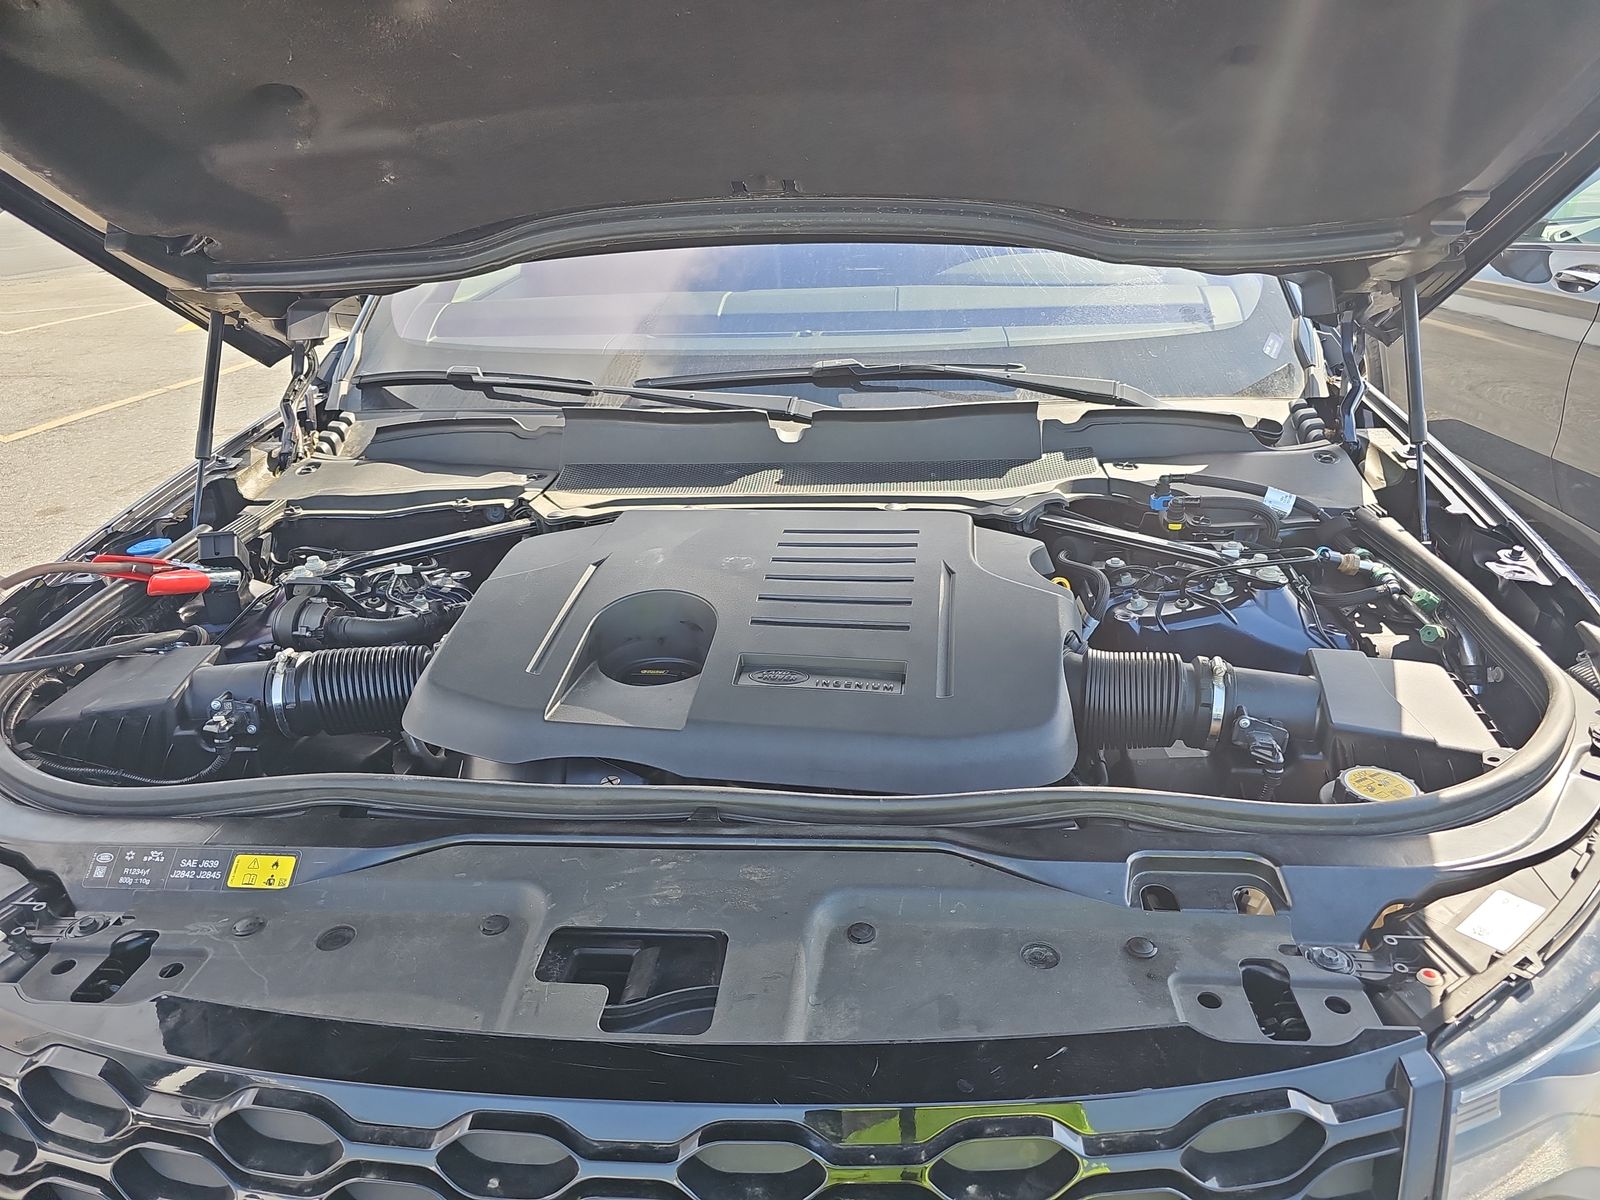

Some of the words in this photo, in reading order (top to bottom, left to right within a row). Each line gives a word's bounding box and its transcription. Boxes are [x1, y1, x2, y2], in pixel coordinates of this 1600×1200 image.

[761, 674, 798, 682] ROVER
[815, 679, 894, 692] INGENIUM
[180, 859, 197, 868] SAE
[198, 860, 219, 868] J639
[123, 868, 151, 876] R1234yf
[170, 870, 196, 879] J2842
[196, 871, 221, 880] J2845
